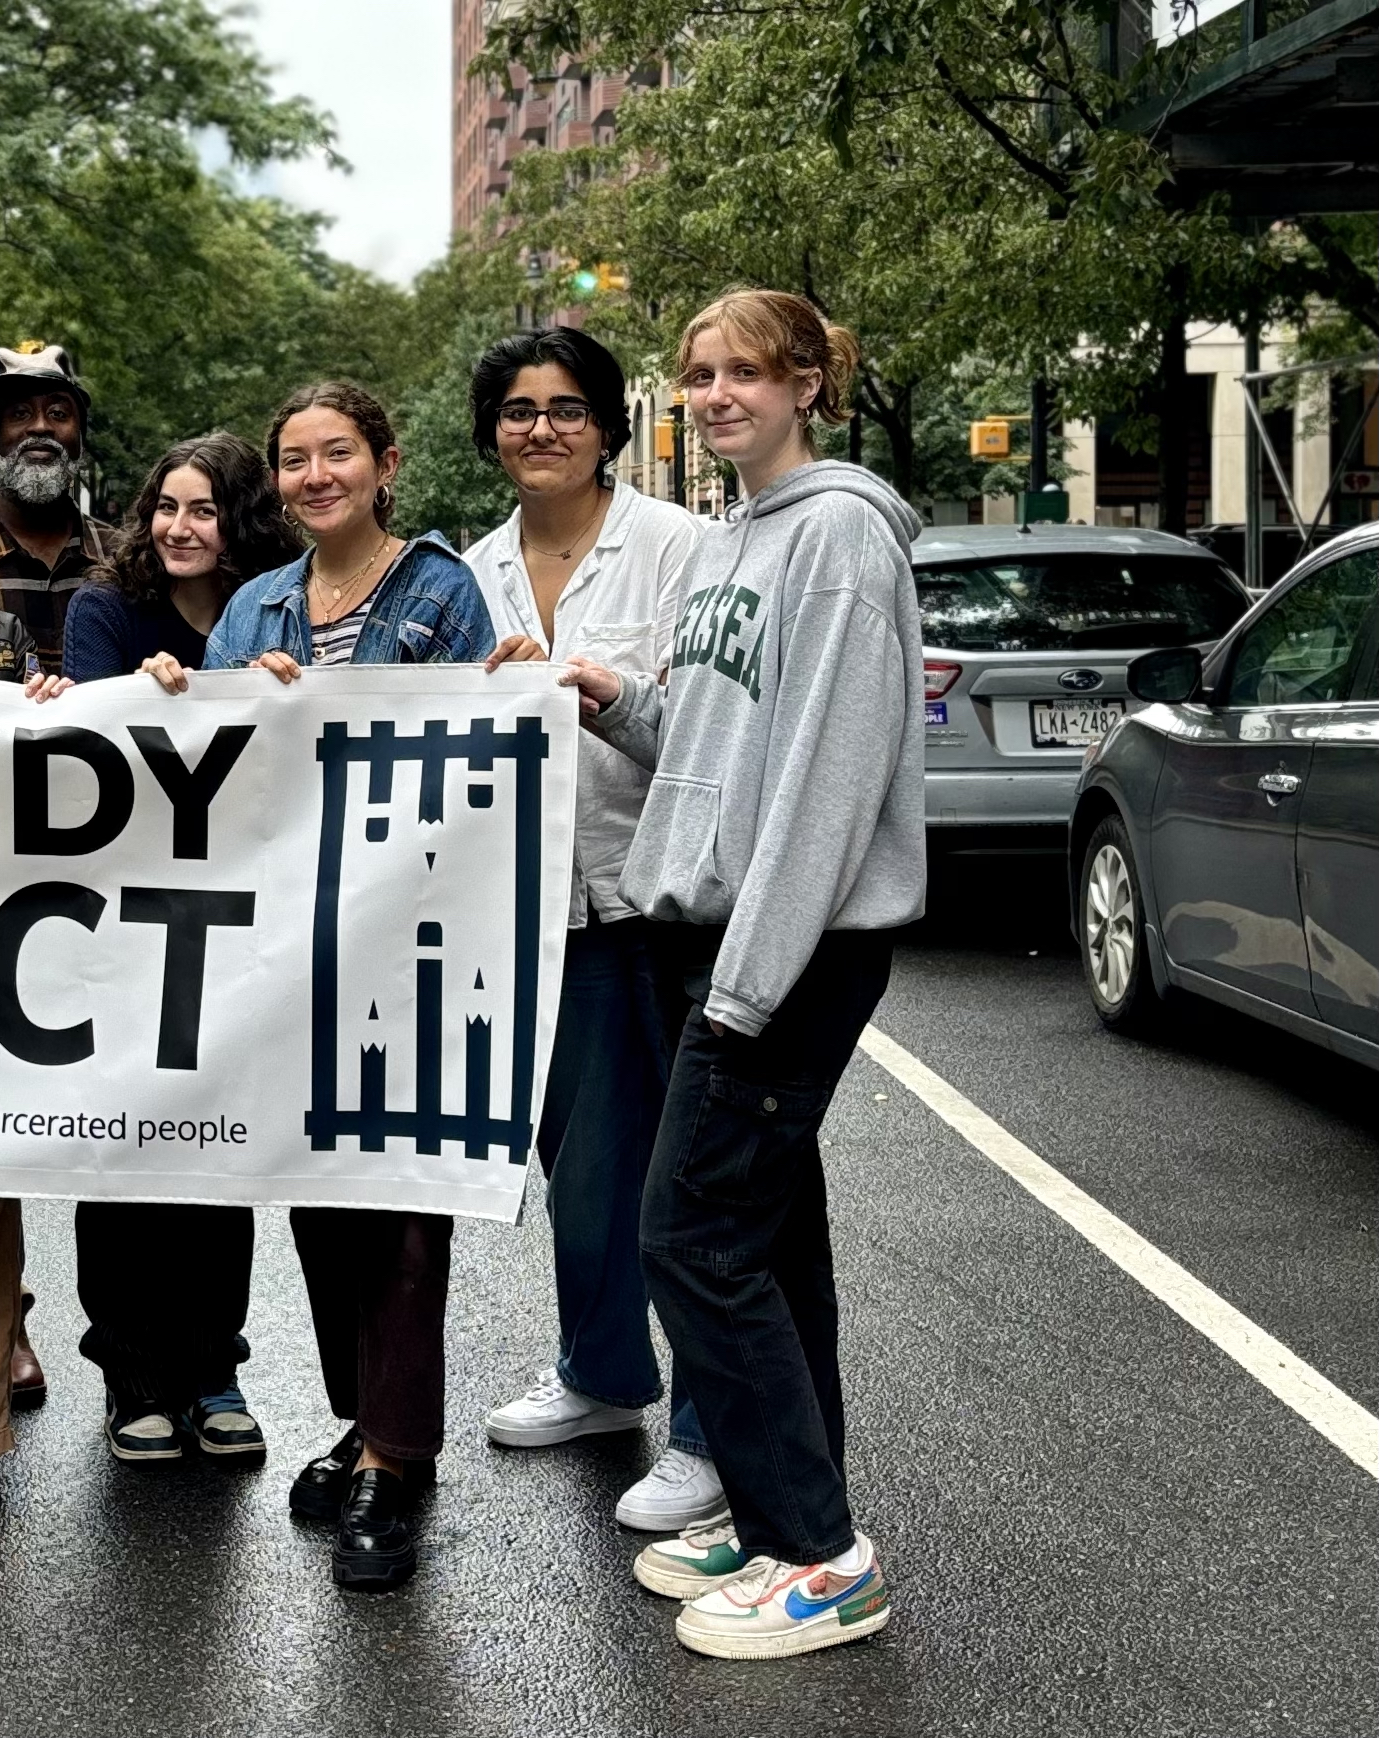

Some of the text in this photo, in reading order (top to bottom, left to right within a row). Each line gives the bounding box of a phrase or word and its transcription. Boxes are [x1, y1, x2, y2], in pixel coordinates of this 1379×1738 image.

[671, 584, 770, 704] ELSEA
[1038, 711, 1069, 735] LKA
[138, 1114, 248, 1149] people
